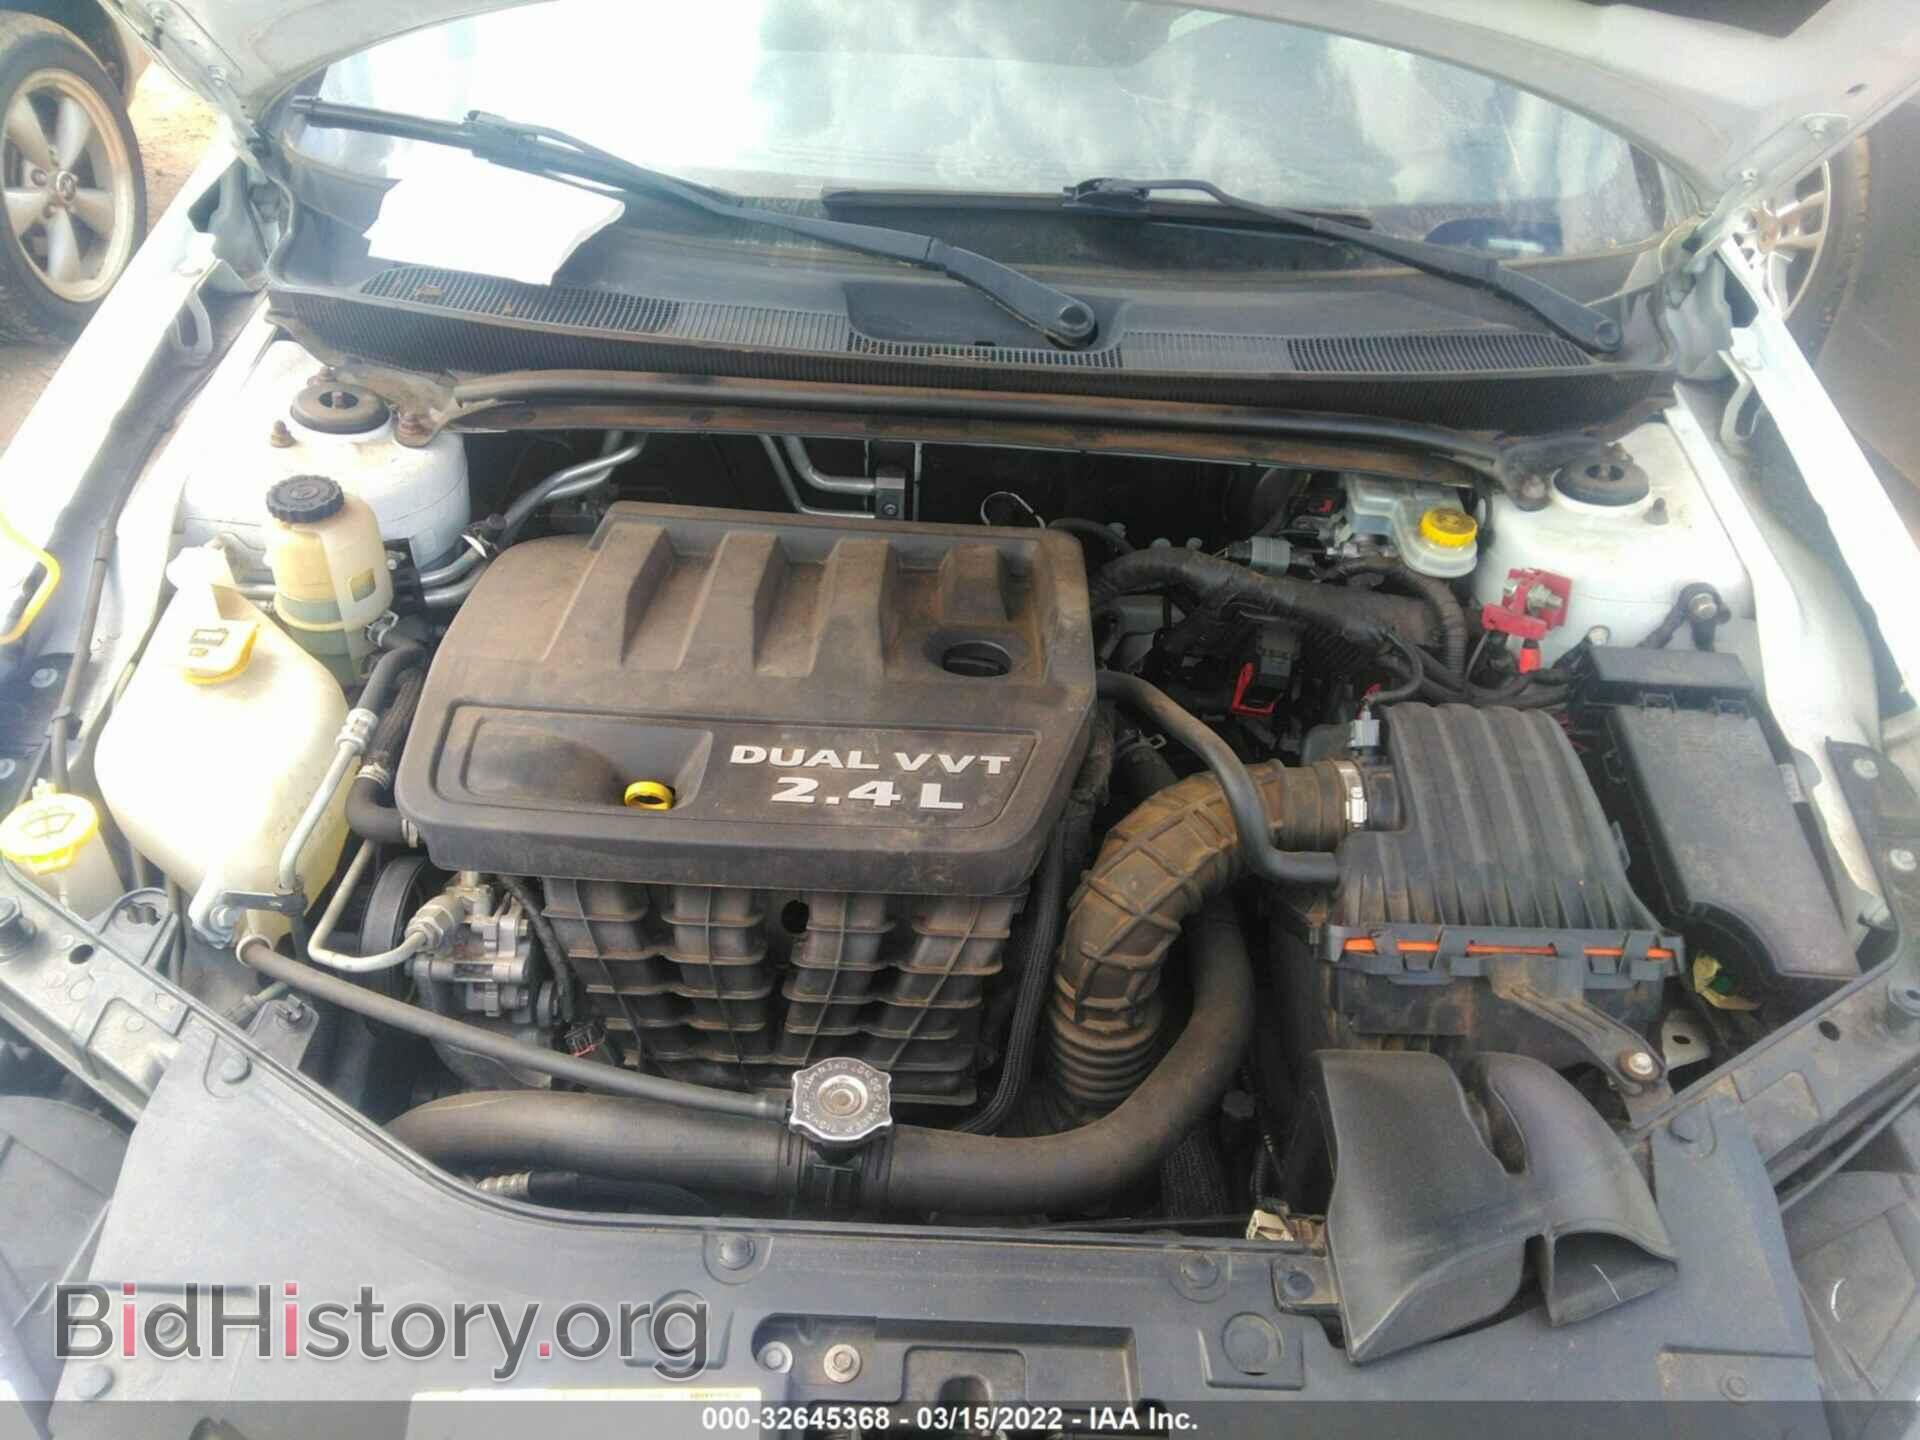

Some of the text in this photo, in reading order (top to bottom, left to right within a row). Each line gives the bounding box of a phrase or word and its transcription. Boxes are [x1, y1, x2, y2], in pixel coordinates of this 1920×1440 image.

[729, 745, 1011, 774] DUAL VVT
[770, 776, 964, 809] 2.4 L
